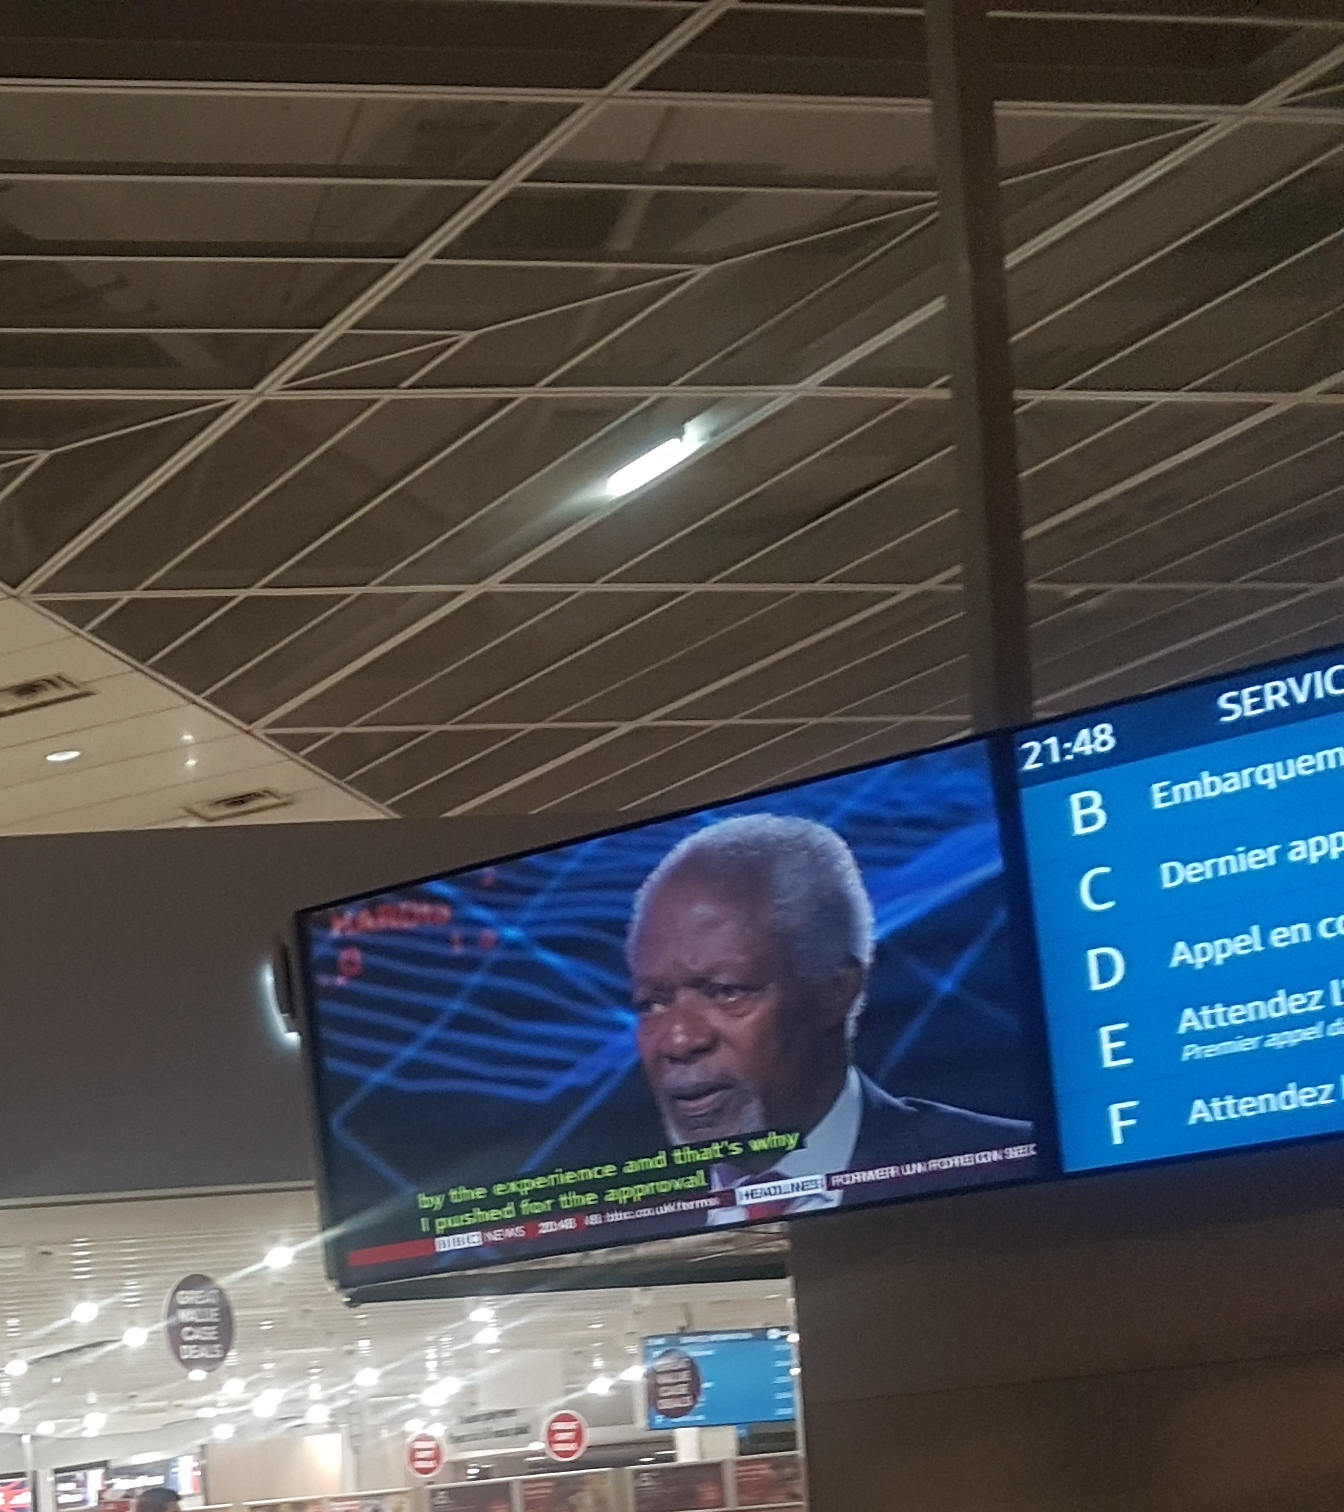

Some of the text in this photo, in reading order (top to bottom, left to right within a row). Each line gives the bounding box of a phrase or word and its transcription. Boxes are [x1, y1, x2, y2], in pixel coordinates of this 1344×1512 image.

[1019, 722, 1116, 771] 21:48
[1069, 789, 1108, 836] B
[1079, 866, 1117, 911] C
[1160, 845, 1283, 889] Dernier
[1086, 946, 1126, 991] D
[1168, 924, 1266, 970] Appel
[1269, 922, 1312, 948] en
[1099, 1022, 1134, 1068] E
[1177, 989, 1326, 1034] Attendez
[1181, 1035, 1264, 1063] Premier
[1264, 1021, 1325, 1049] appel
[1107, 1100, 1140, 1145] F
[1187, 1081, 1337, 1125] Attendez
[417, 1131, 800, 1211] by the experience and that's why
[435, 1202, 517, 1234] pushed
[520, 1198, 556, 1215] for
[559, 1191, 599, 1210] the
[604, 1169, 708, 1205] approval
